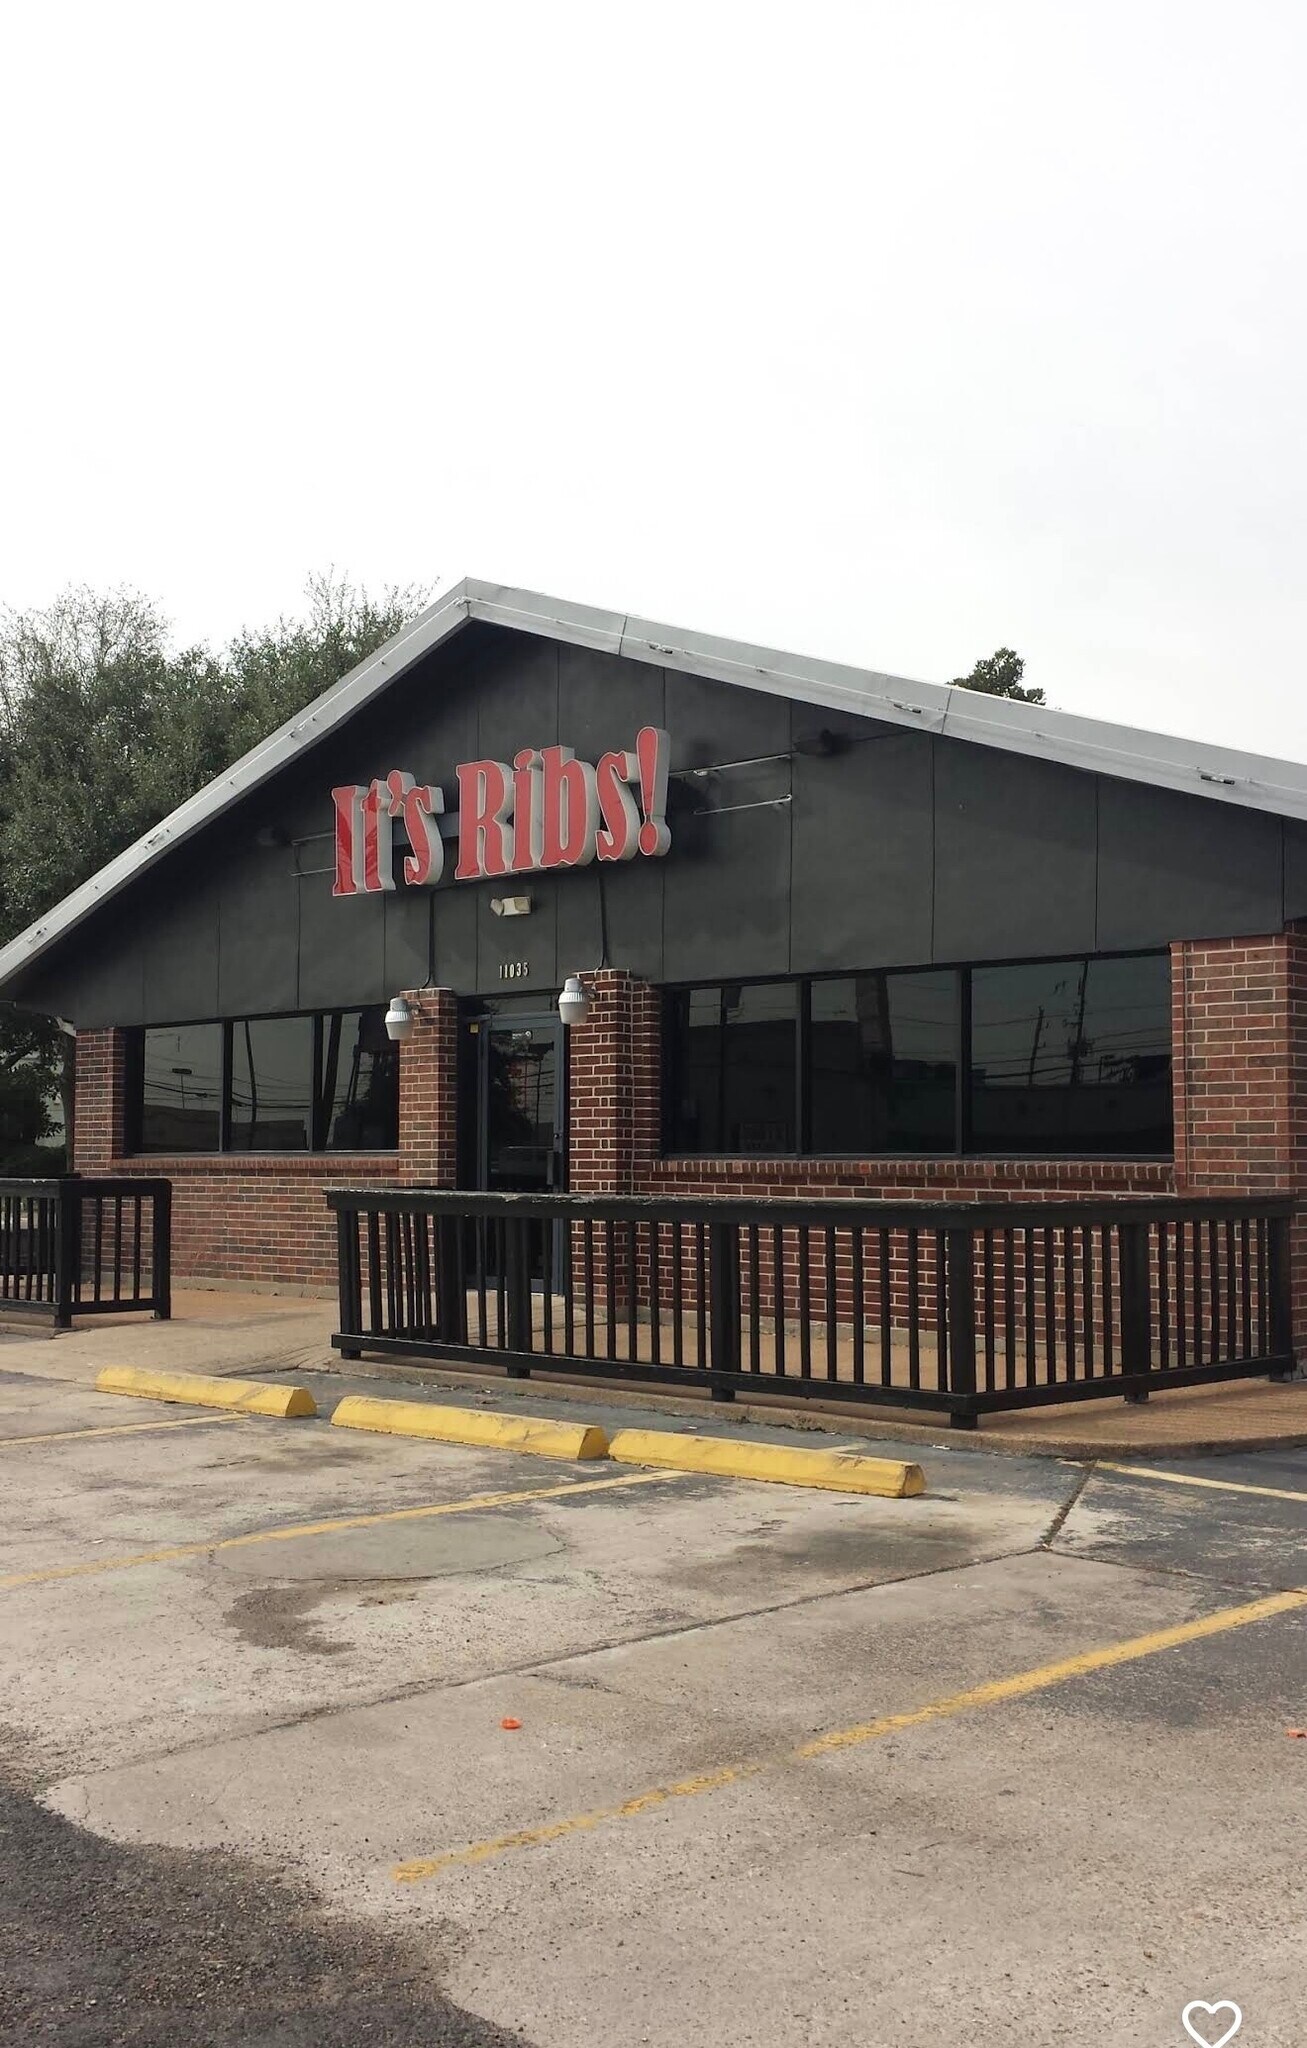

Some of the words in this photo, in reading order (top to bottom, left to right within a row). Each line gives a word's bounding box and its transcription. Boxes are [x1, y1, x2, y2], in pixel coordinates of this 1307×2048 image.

[332, 770, 443, 896] It's
[455, 726, 670, 879] Ribs!
[499, 962, 529, 979] 11035
